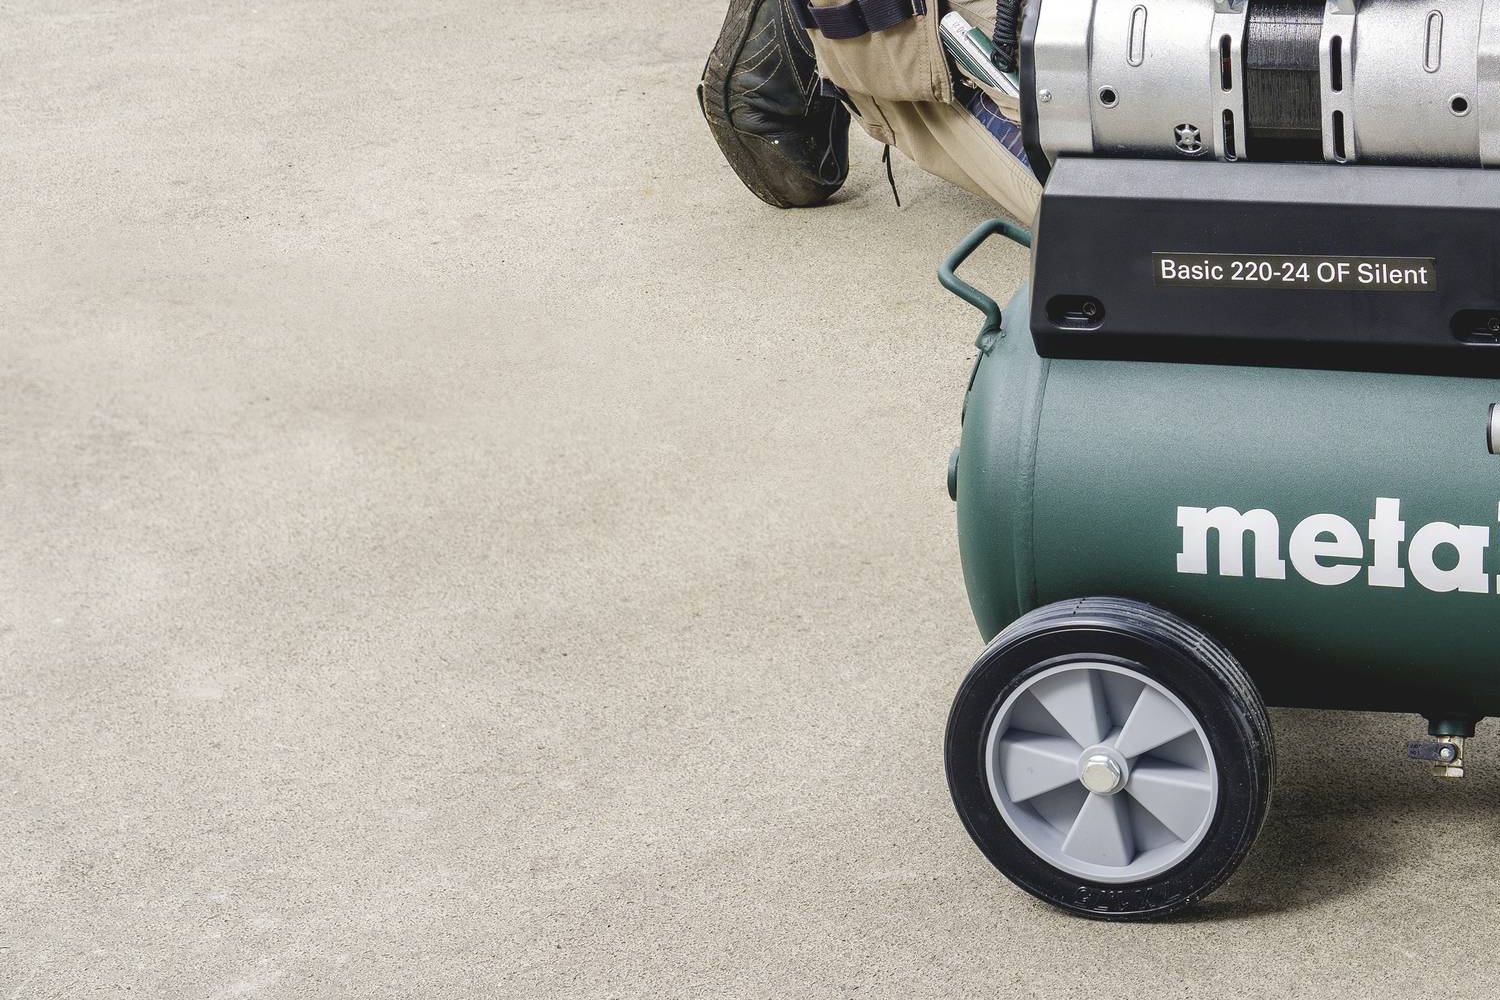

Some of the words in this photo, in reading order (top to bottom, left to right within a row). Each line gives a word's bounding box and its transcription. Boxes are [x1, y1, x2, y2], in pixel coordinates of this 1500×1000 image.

[1160, 259, 1224, 280] Basic
[1230, 261, 1310, 283] 220-24
[1316, 262, 1350, 283] OF
[1357, 263, 1428, 285] Silent
